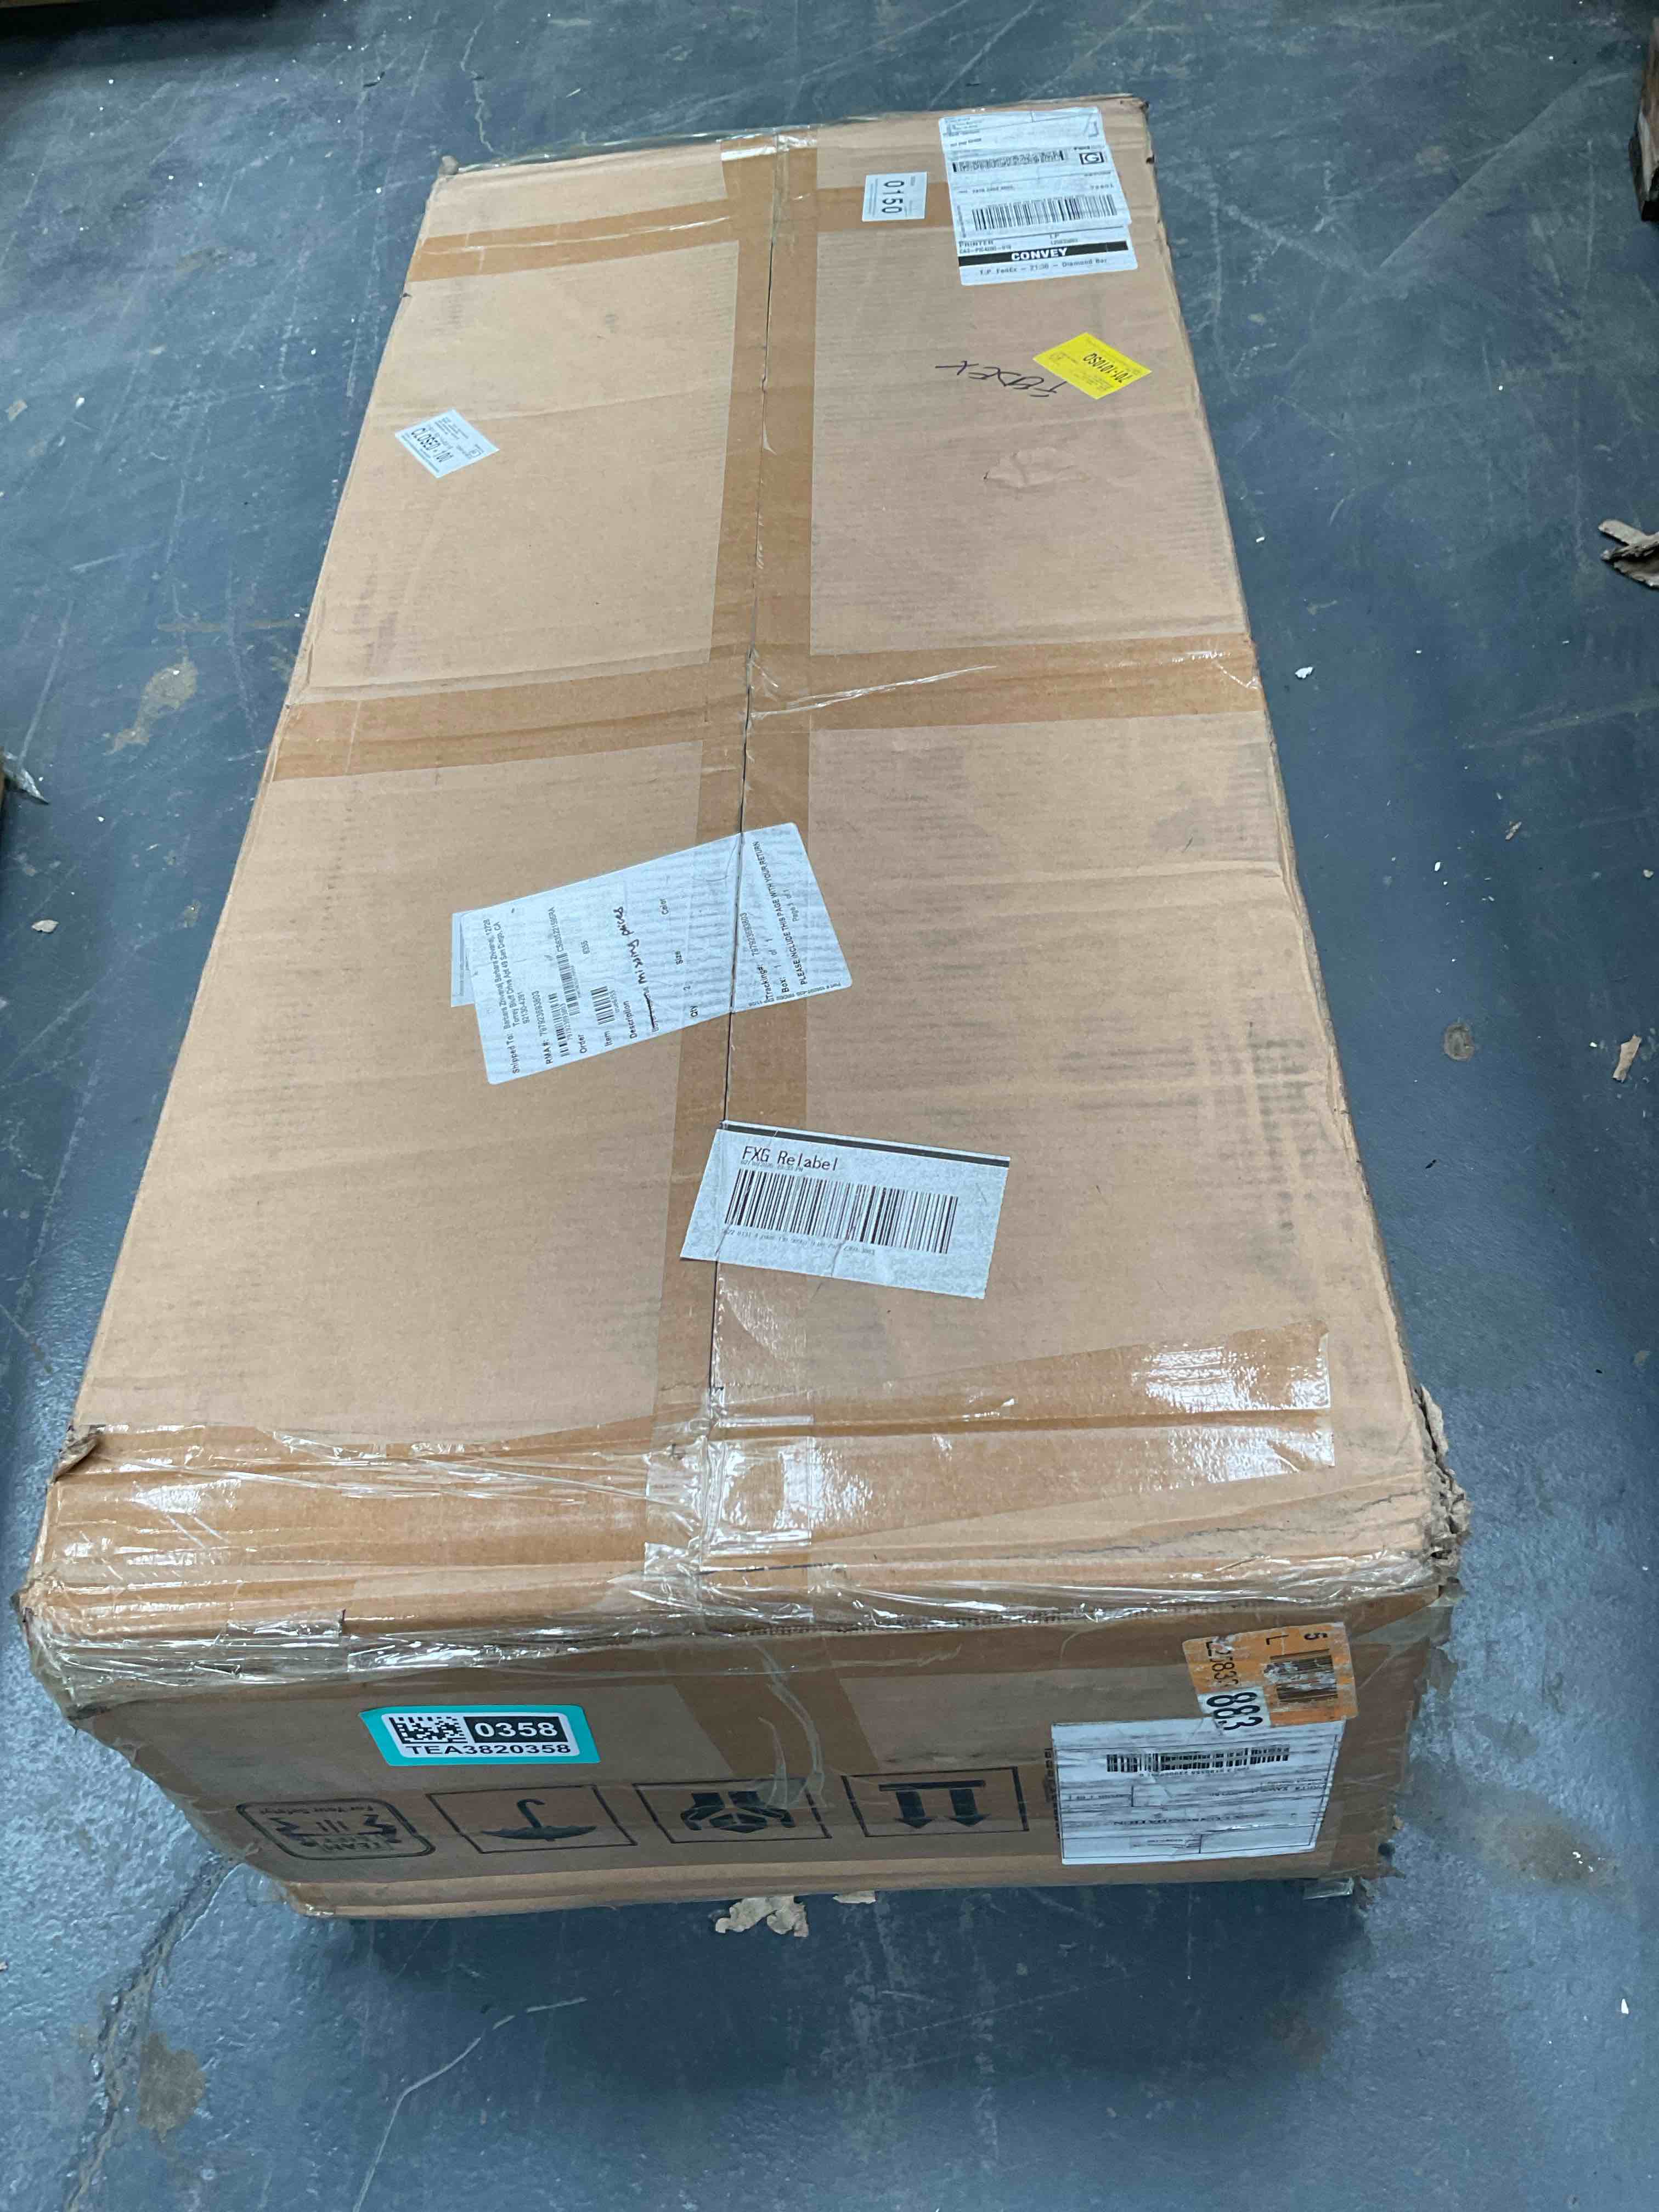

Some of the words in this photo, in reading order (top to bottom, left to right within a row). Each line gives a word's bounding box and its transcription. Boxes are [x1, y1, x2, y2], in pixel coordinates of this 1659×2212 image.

[882, 179, 905, 215] 0150
[1011, 247, 1068, 262] CONVEY
[1062, 258, 1092, 267] Diamond
[751, 840, 766, 865] RETURN
[760, 865, 772, 883] YOUR
[766, 882, 777, 898] WITH
[658, 898, 669, 915] Color
[771, 899, 784, 917] PAGE
[788, 906, 800, 922] Page
[777, 917, 788, 931] THIS
[782, 931, 798, 959] INCLUDE
[627, 939, 647, 984] missing
[673, 950, 684, 964] Size
[791, 959, 807, 985] PLEASE
[778, 976, 789, 992] Box:
[622, 1000, 637, 1039] Description
[689, 1005, 699, 1017] Qty
[577, 1034, 588, 1053] Order
[602, 1030, 612, 1046] Item
[507, 1045, 520, 1074] Shipped
[543, 1047, 553, 1064] RMA
[742, 1146, 771, 1163] FXG
[777, 1150, 838, 1171] Relabel
[1206, 1691, 1263, 1730] 883
[475, 1722, 557, 1737] 0358
[406, 1743, 571, 1754] TEA3820358
